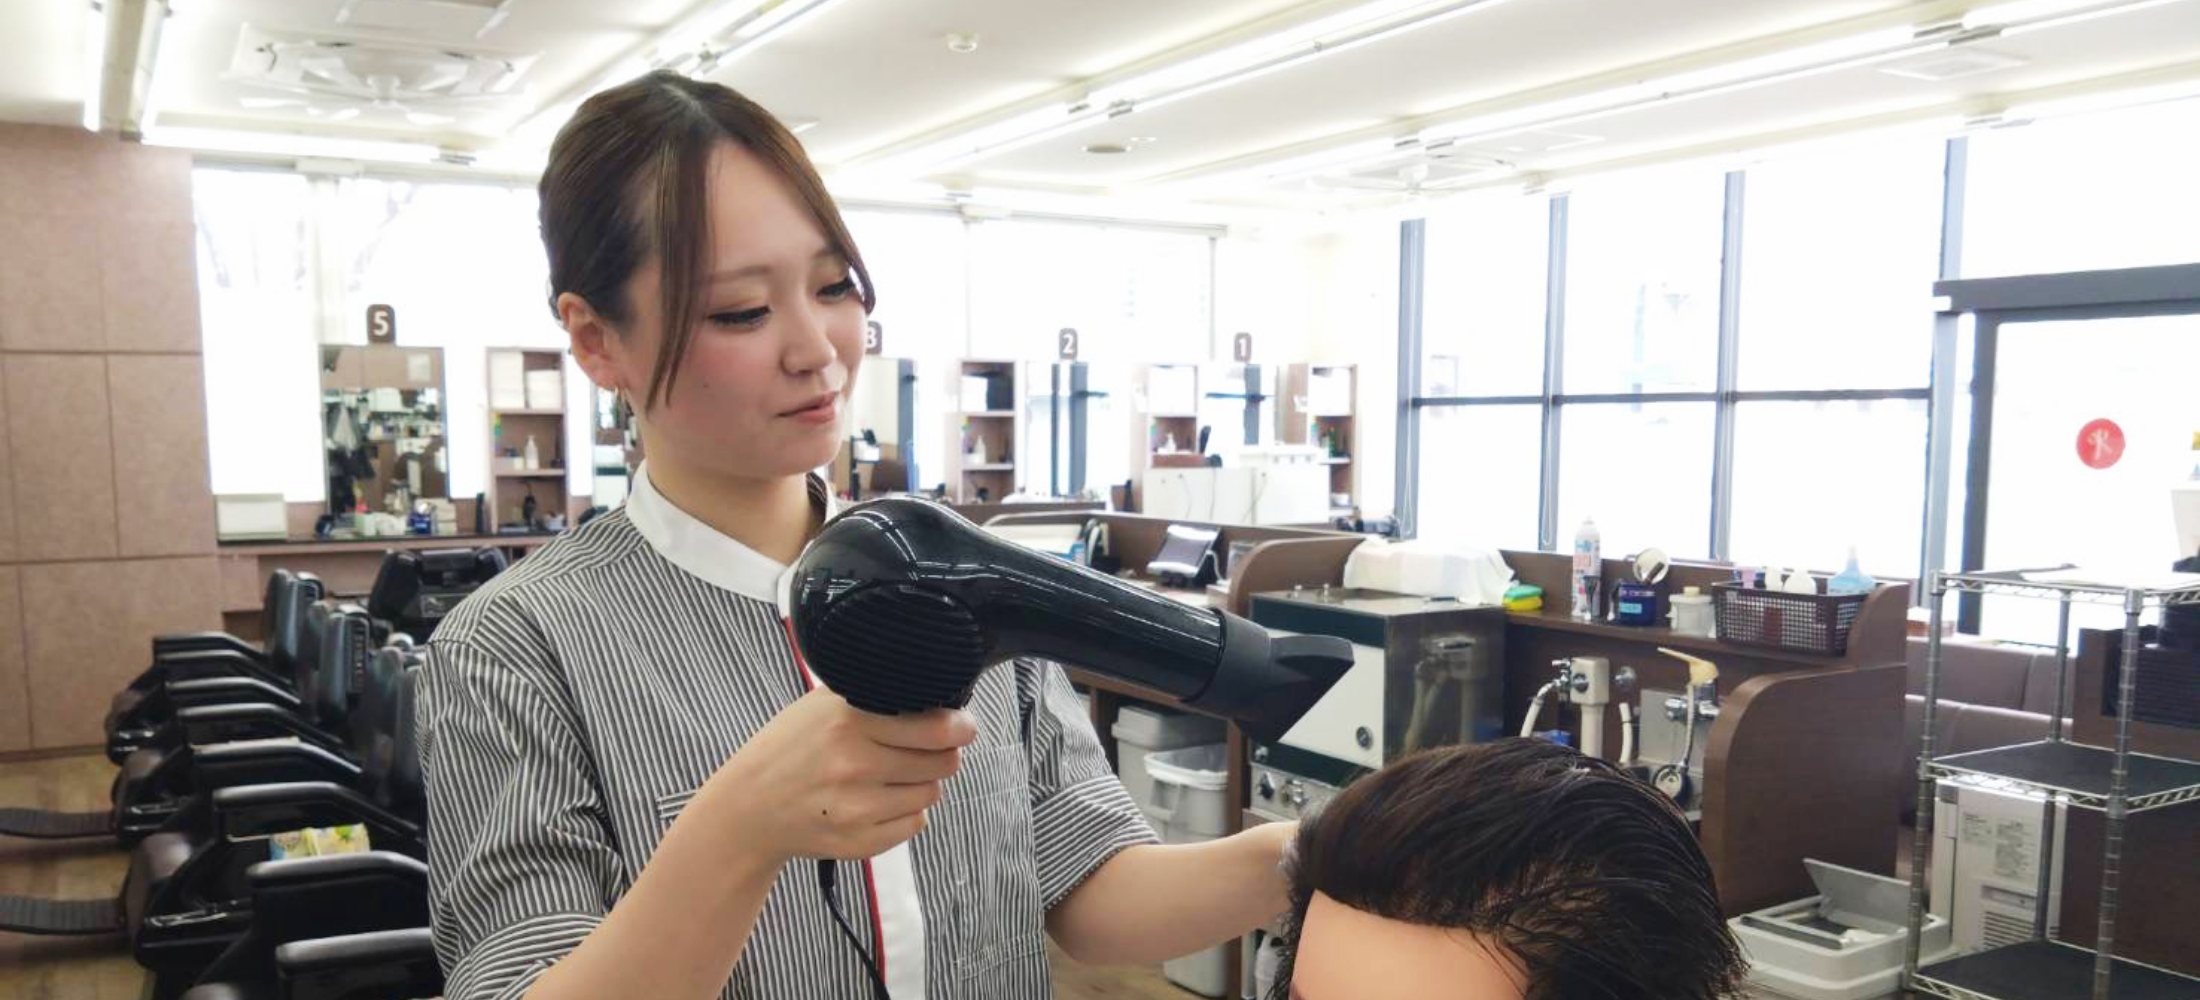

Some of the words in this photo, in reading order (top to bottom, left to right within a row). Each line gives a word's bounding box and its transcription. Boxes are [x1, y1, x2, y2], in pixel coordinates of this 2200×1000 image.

[373, 311, 389, 337] 5
[1062, 333, 1075, 354] 2
[1238, 338, 1247, 357] 1
